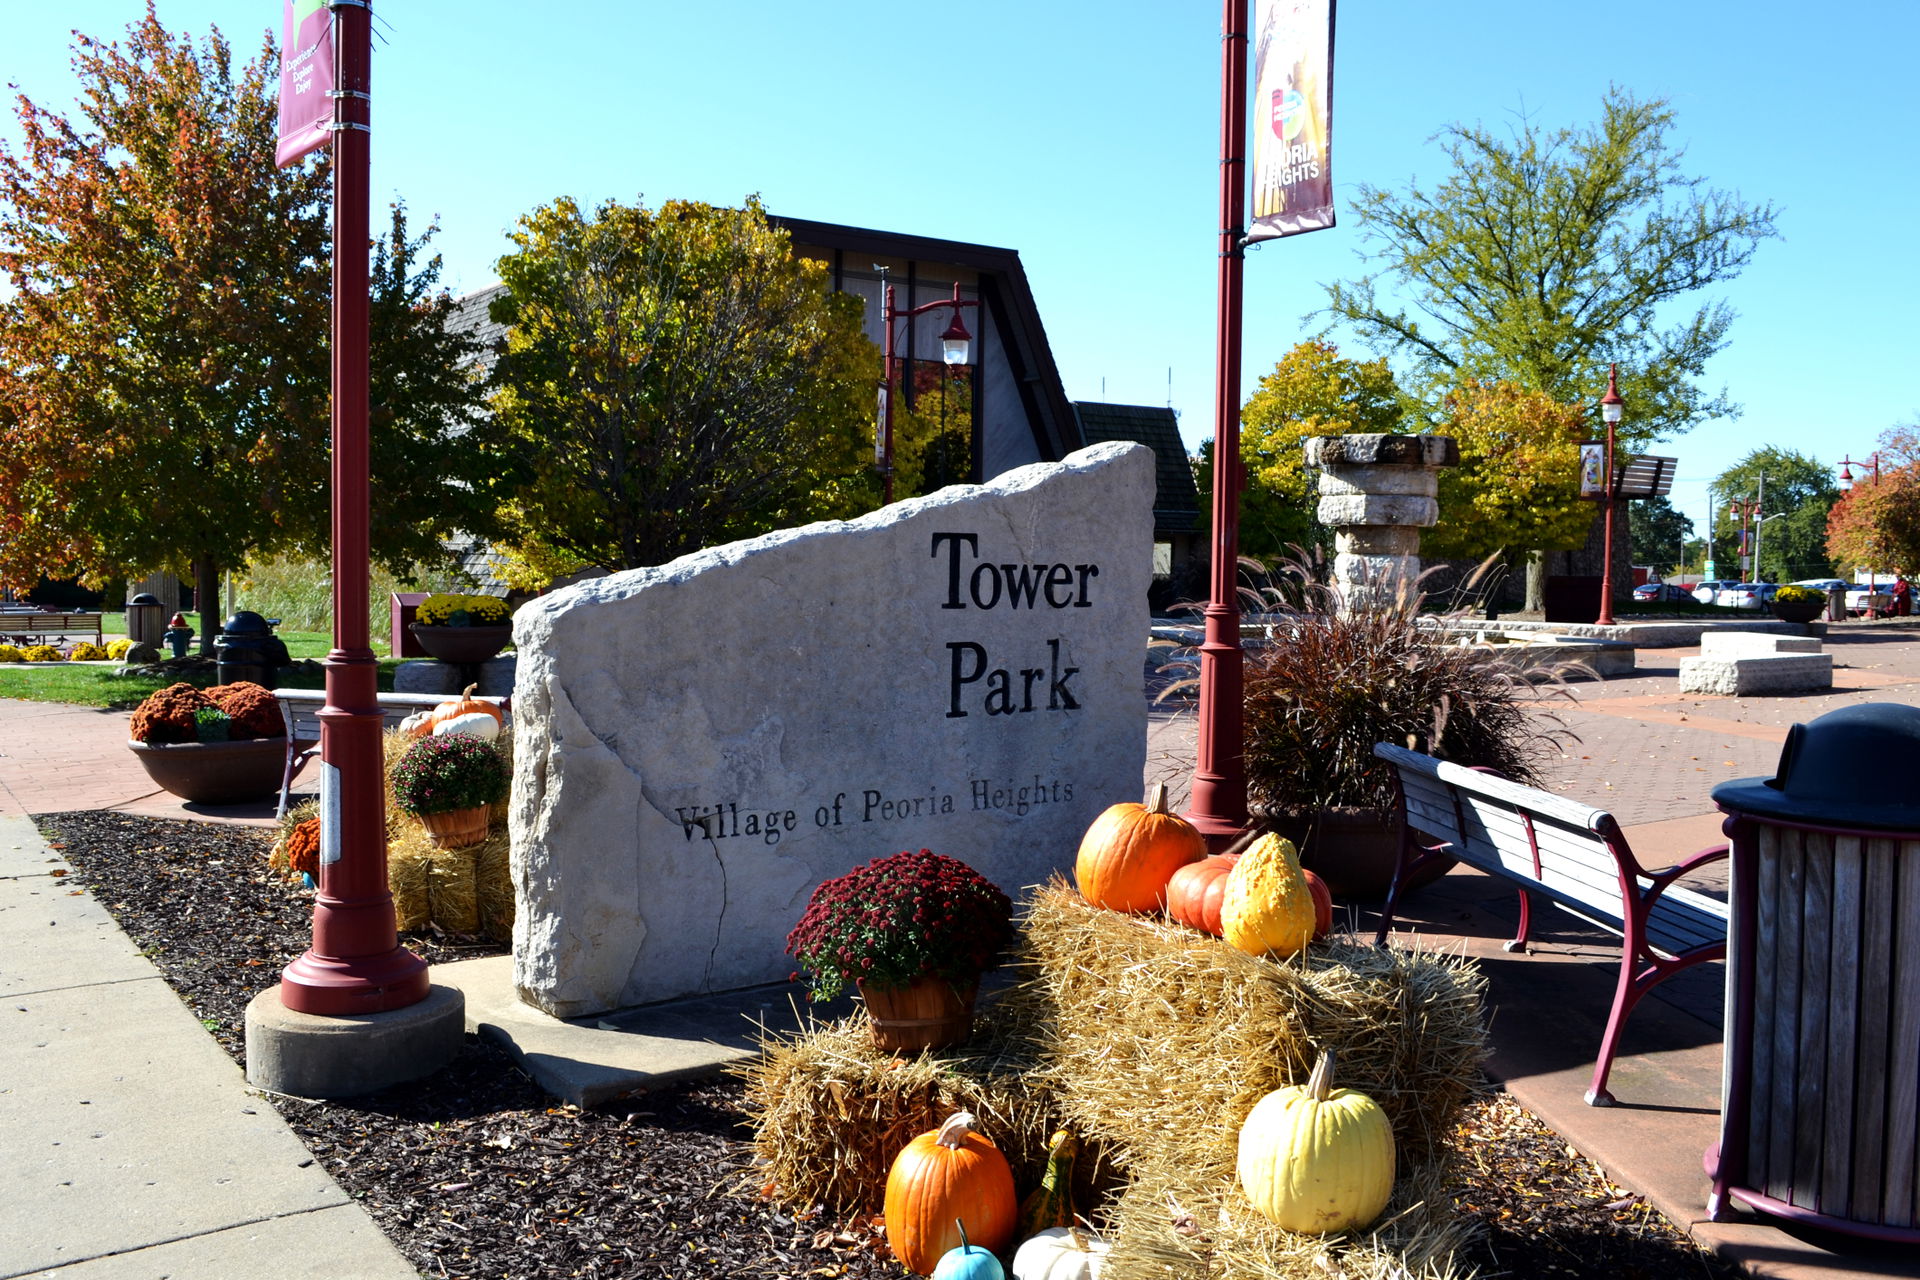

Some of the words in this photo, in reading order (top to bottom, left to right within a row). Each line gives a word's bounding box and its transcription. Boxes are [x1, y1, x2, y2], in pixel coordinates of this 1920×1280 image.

[293, 64, 314, 83] Explore
[295, 79, 311, 95] Enjoy
[1266, 142, 1317, 171] ORIA
[931, 531, 1100, 611] Tower
[945, 639, 1082, 719] Park
[674, 804, 797, 846] Village
[815, 792, 848, 830] of
[863, 789, 956, 823] Peoria
[971, 774, 1075, 817] Heights
